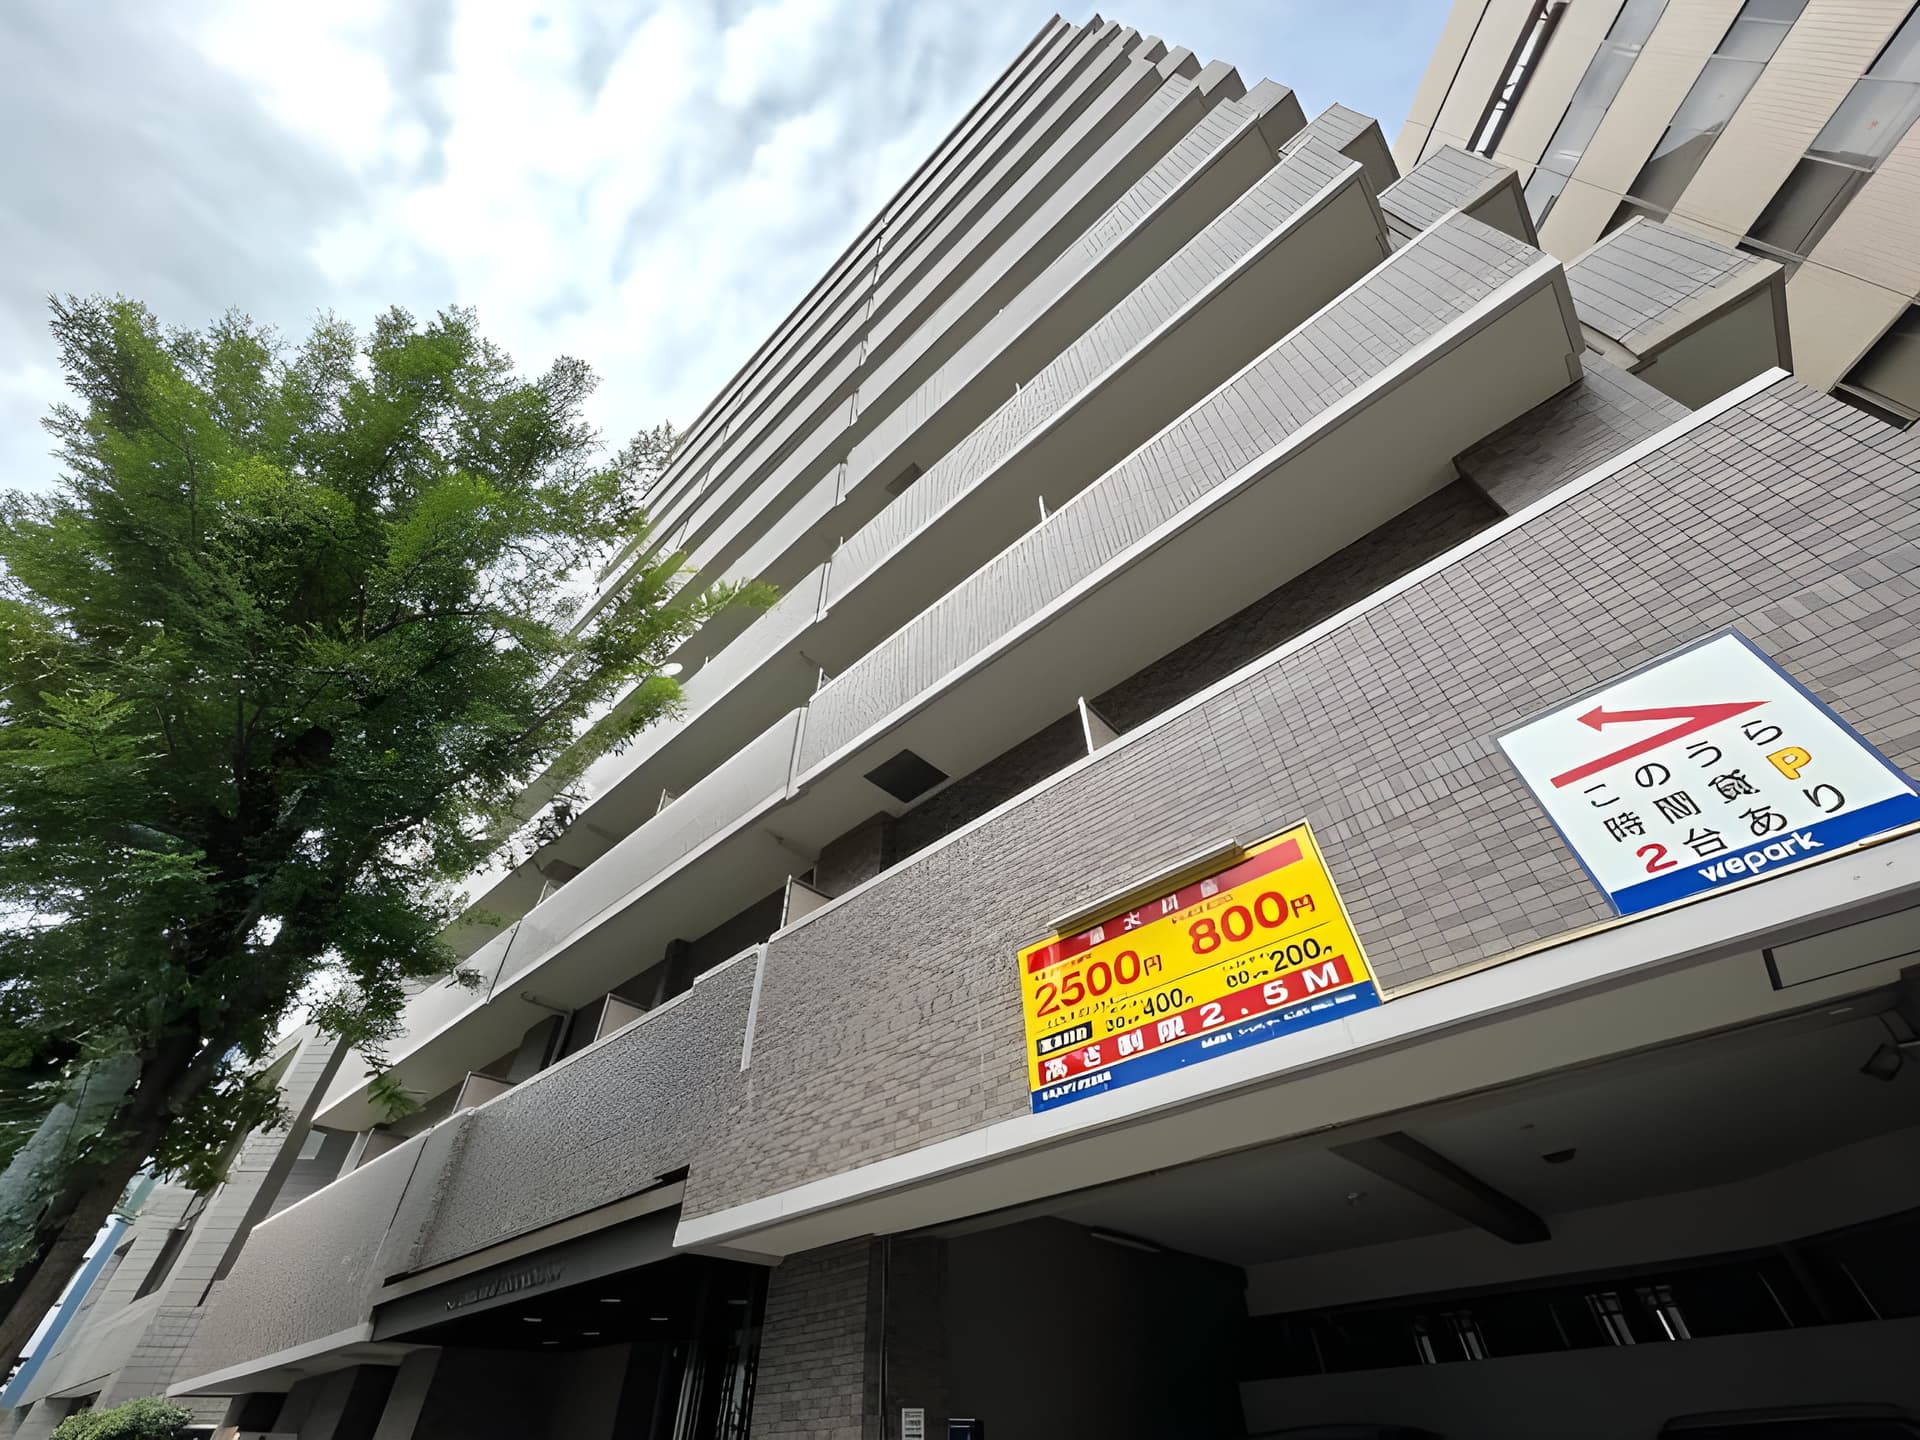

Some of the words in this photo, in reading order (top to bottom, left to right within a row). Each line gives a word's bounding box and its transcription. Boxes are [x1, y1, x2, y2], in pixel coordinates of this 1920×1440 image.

[1584, 720, 1783, 807] このうら
[1636, 784, 1845, 873] 2台あり
[1698, 832, 1824, 882] wepark
[1188, 891, 1315, 955] 800円
[1035, 950, 1162, 1018] 2500円
